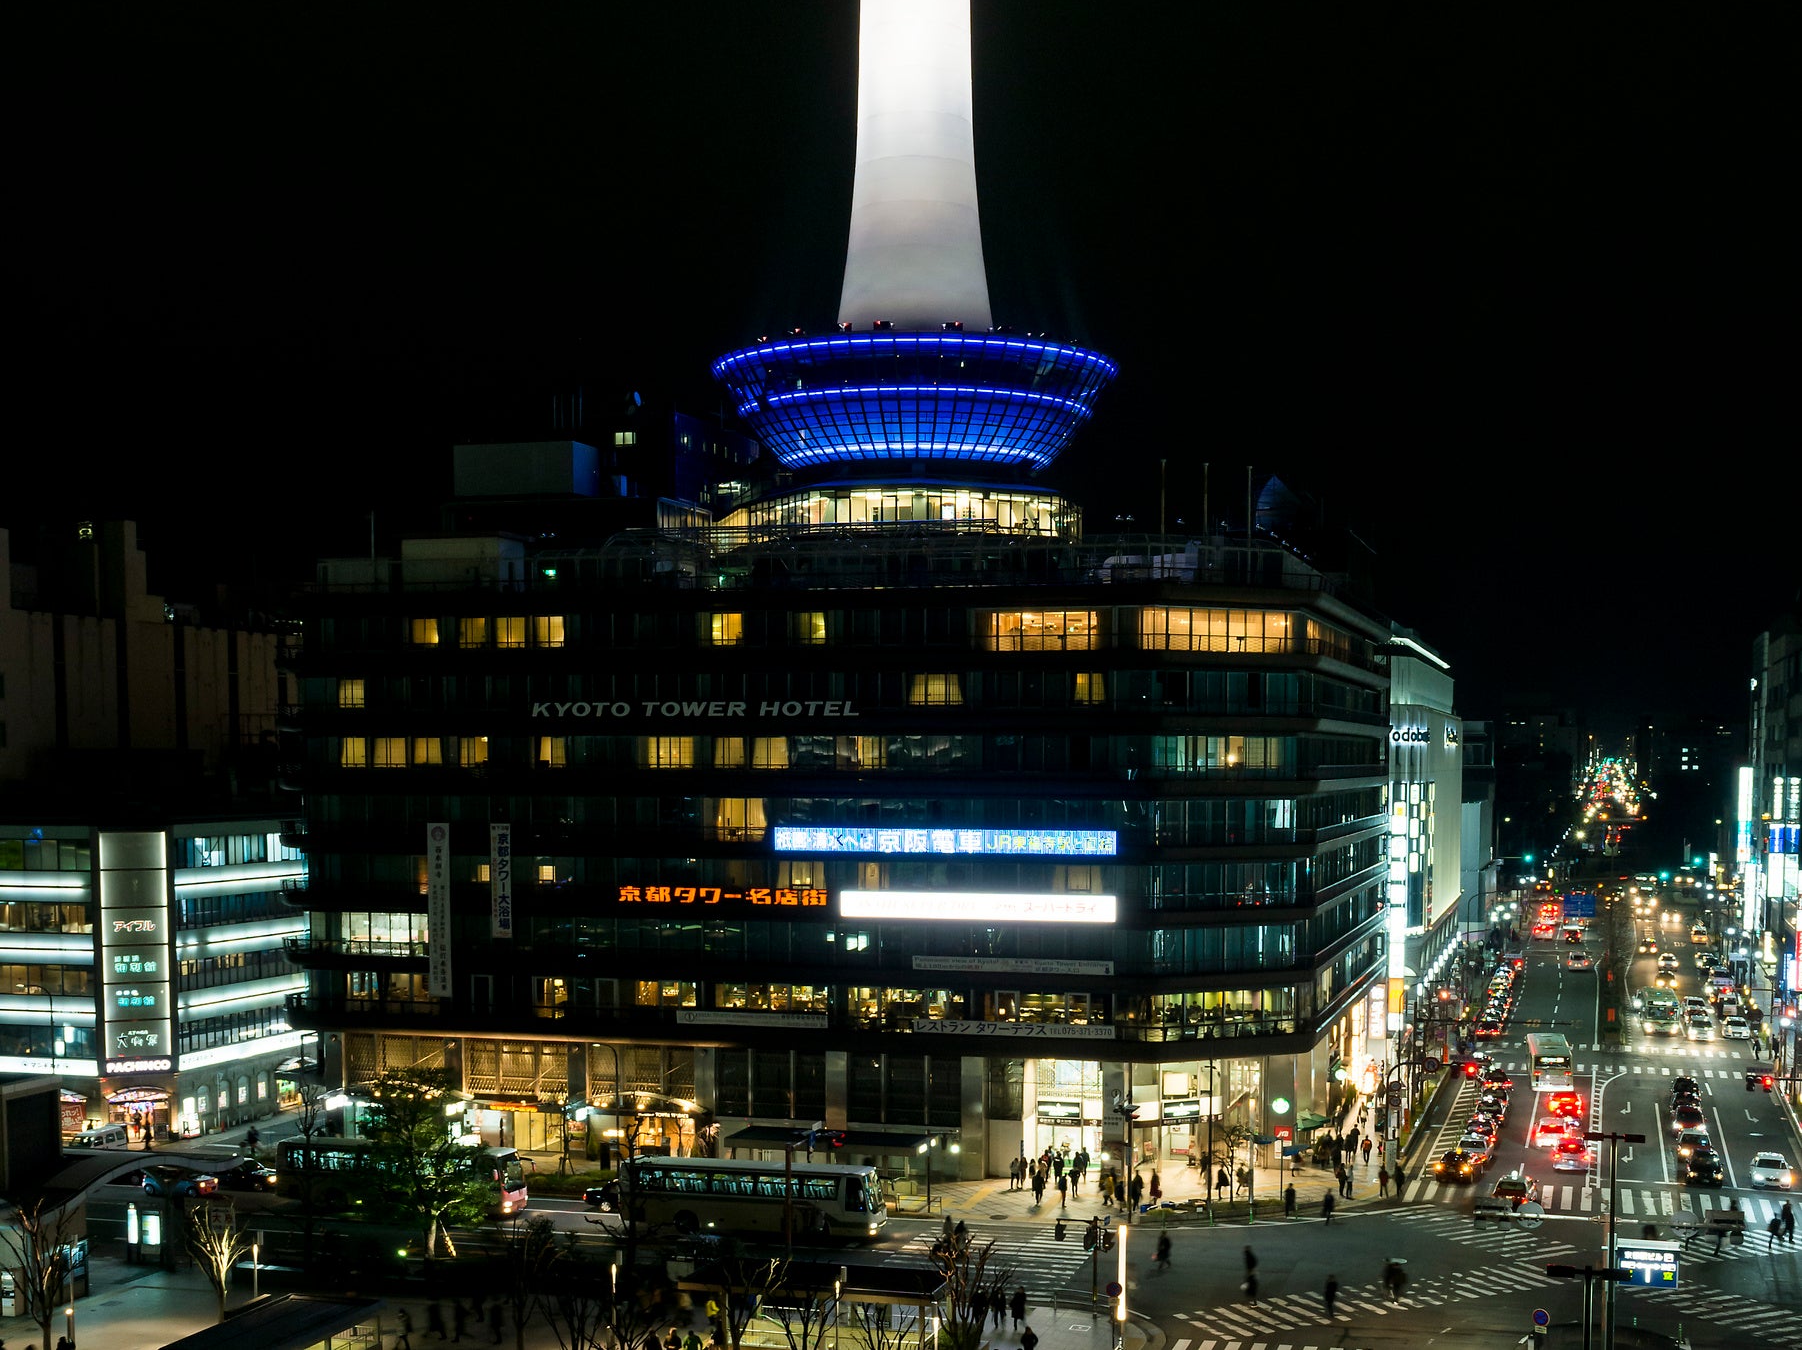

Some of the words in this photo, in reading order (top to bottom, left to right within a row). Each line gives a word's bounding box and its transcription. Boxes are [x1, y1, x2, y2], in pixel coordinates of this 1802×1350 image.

[531, 702, 631, 717] KYOTO
[642, 701, 746, 717] TOWER
[759, 701, 860, 717] HOTEL
[878, 831, 984, 854] 京阪電車
[497, 832, 511, 930] 京都タワー大浴場
[618, 885, 828, 907] 京都タワー名店街
[113, 920, 156, 932] アイフル
[916, 1021, 971, 1033] レストラン
[975, 1022, 1047, 1035] タワーテラス
[106, 1060, 172, 1074] PACHINCO
